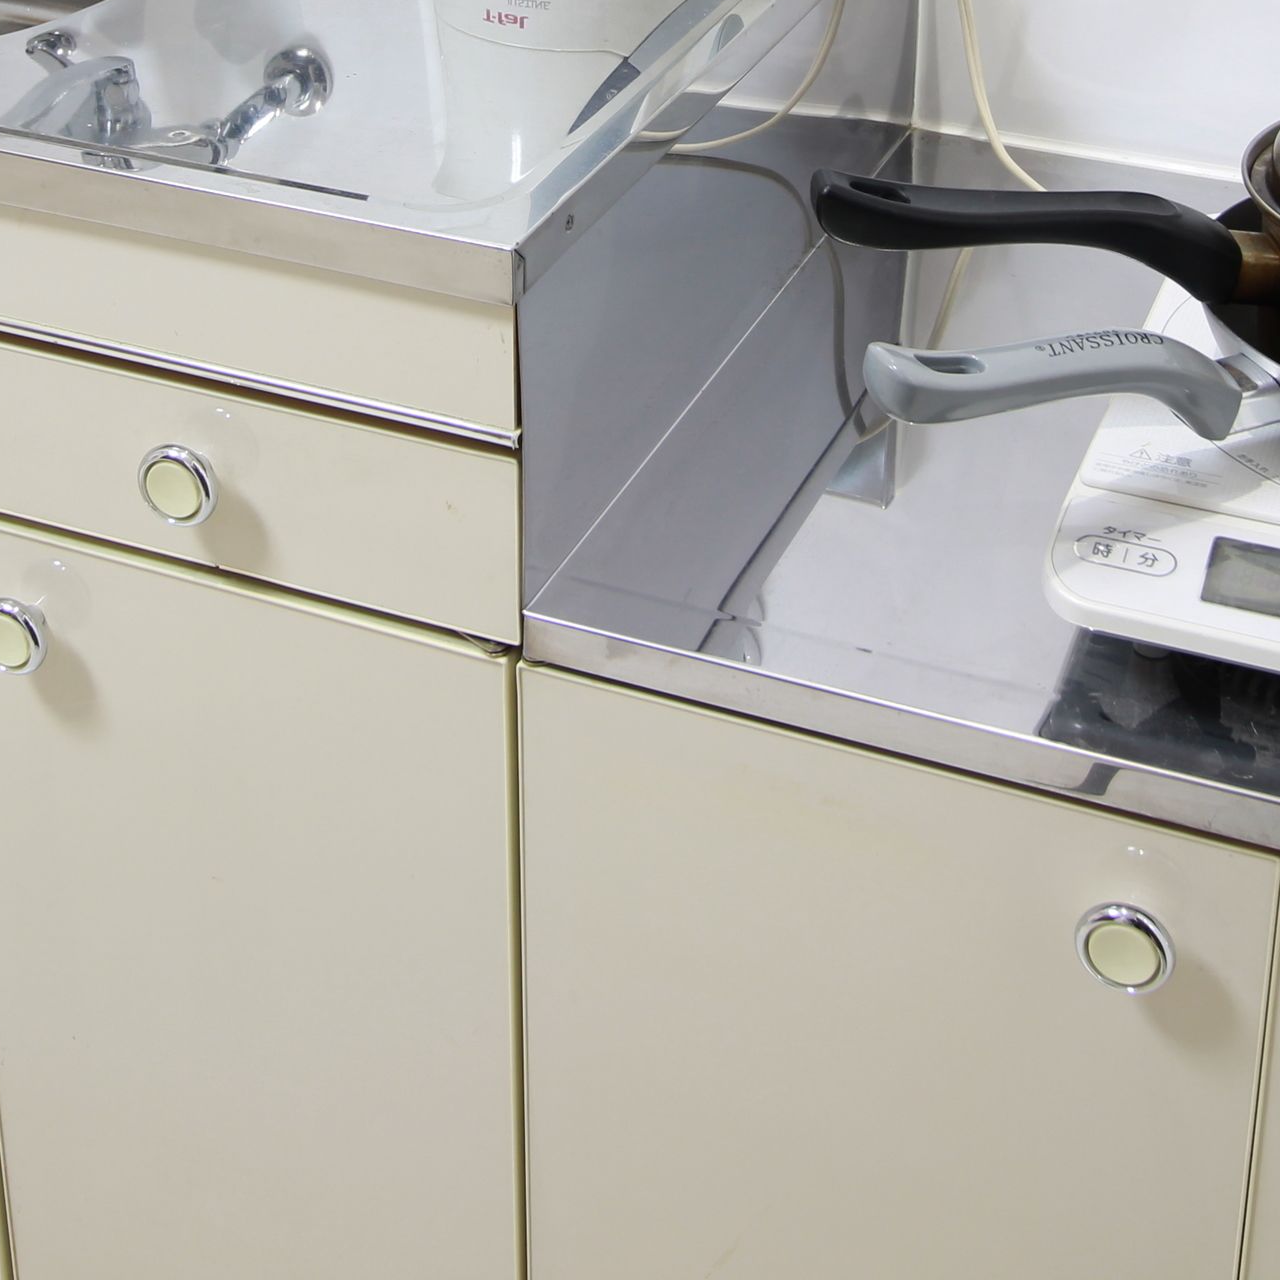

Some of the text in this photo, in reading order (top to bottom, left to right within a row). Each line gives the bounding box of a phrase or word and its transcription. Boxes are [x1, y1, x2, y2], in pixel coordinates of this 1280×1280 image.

[1103, 526, 1162, 542] タイマー
[1137, 552, 1159, 568] 分
